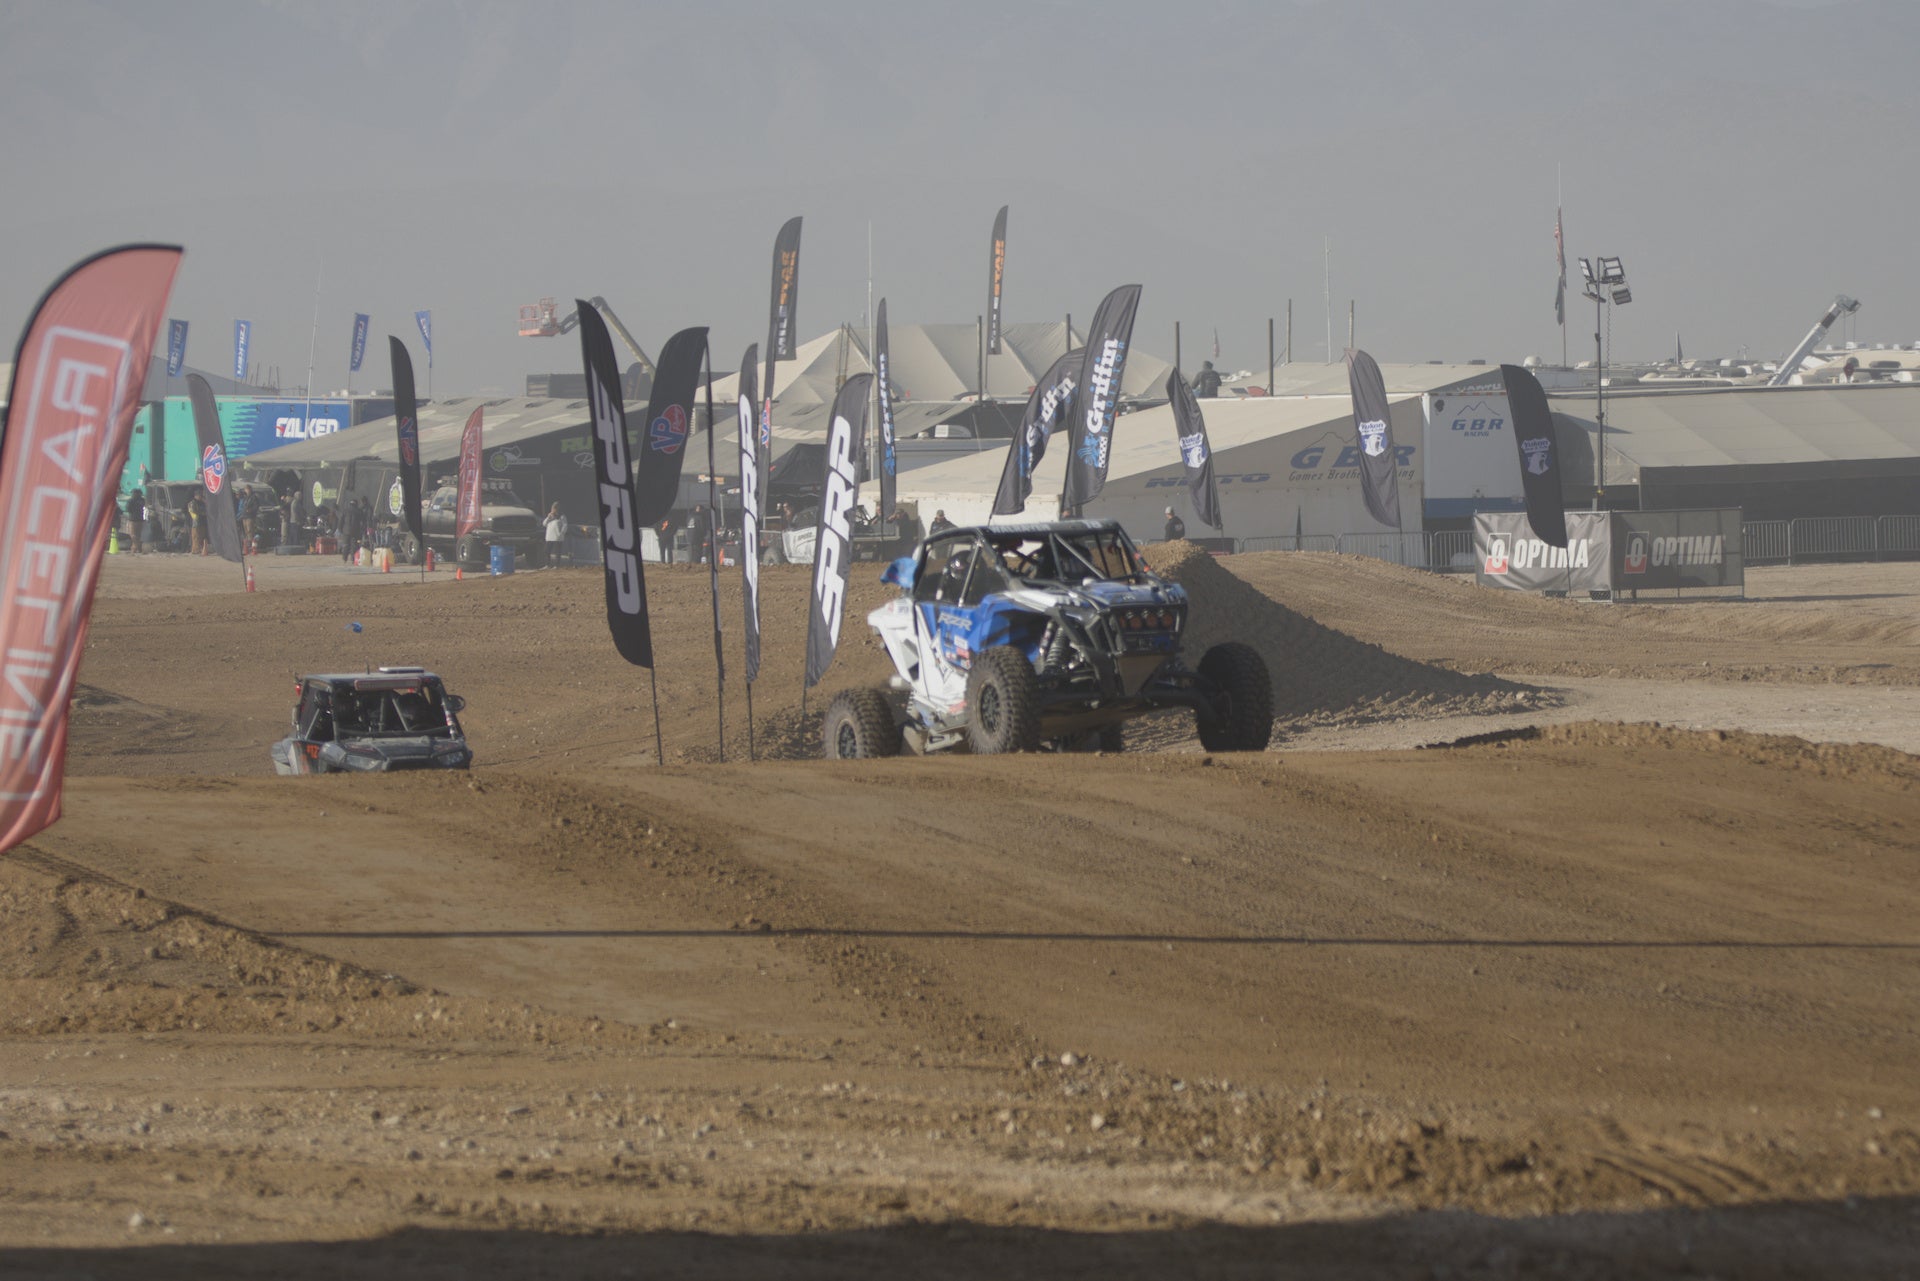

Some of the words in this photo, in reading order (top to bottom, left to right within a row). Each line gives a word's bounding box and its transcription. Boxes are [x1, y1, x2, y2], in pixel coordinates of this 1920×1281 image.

[1086, 337, 1119, 434] Griffin
[1102, 341, 1125, 432] RADIATOR
[275, 417, 339, 439] FALKEN
[651, 416, 685, 451] VP
[1451, 418, 1504, 431] GBR
[203, 443, 225, 477] VP
[1327, 469, 1361, 481] Brothe
[590, 359, 641, 615] PRP
[1145, 473, 1271, 489] NITO
[816, 415, 857, 649] PRP
[1513, 538, 1589, 569] OPTIMA
[1651, 535, 1723, 567] OPTIMA
[937, 612, 973, 631] RZR
